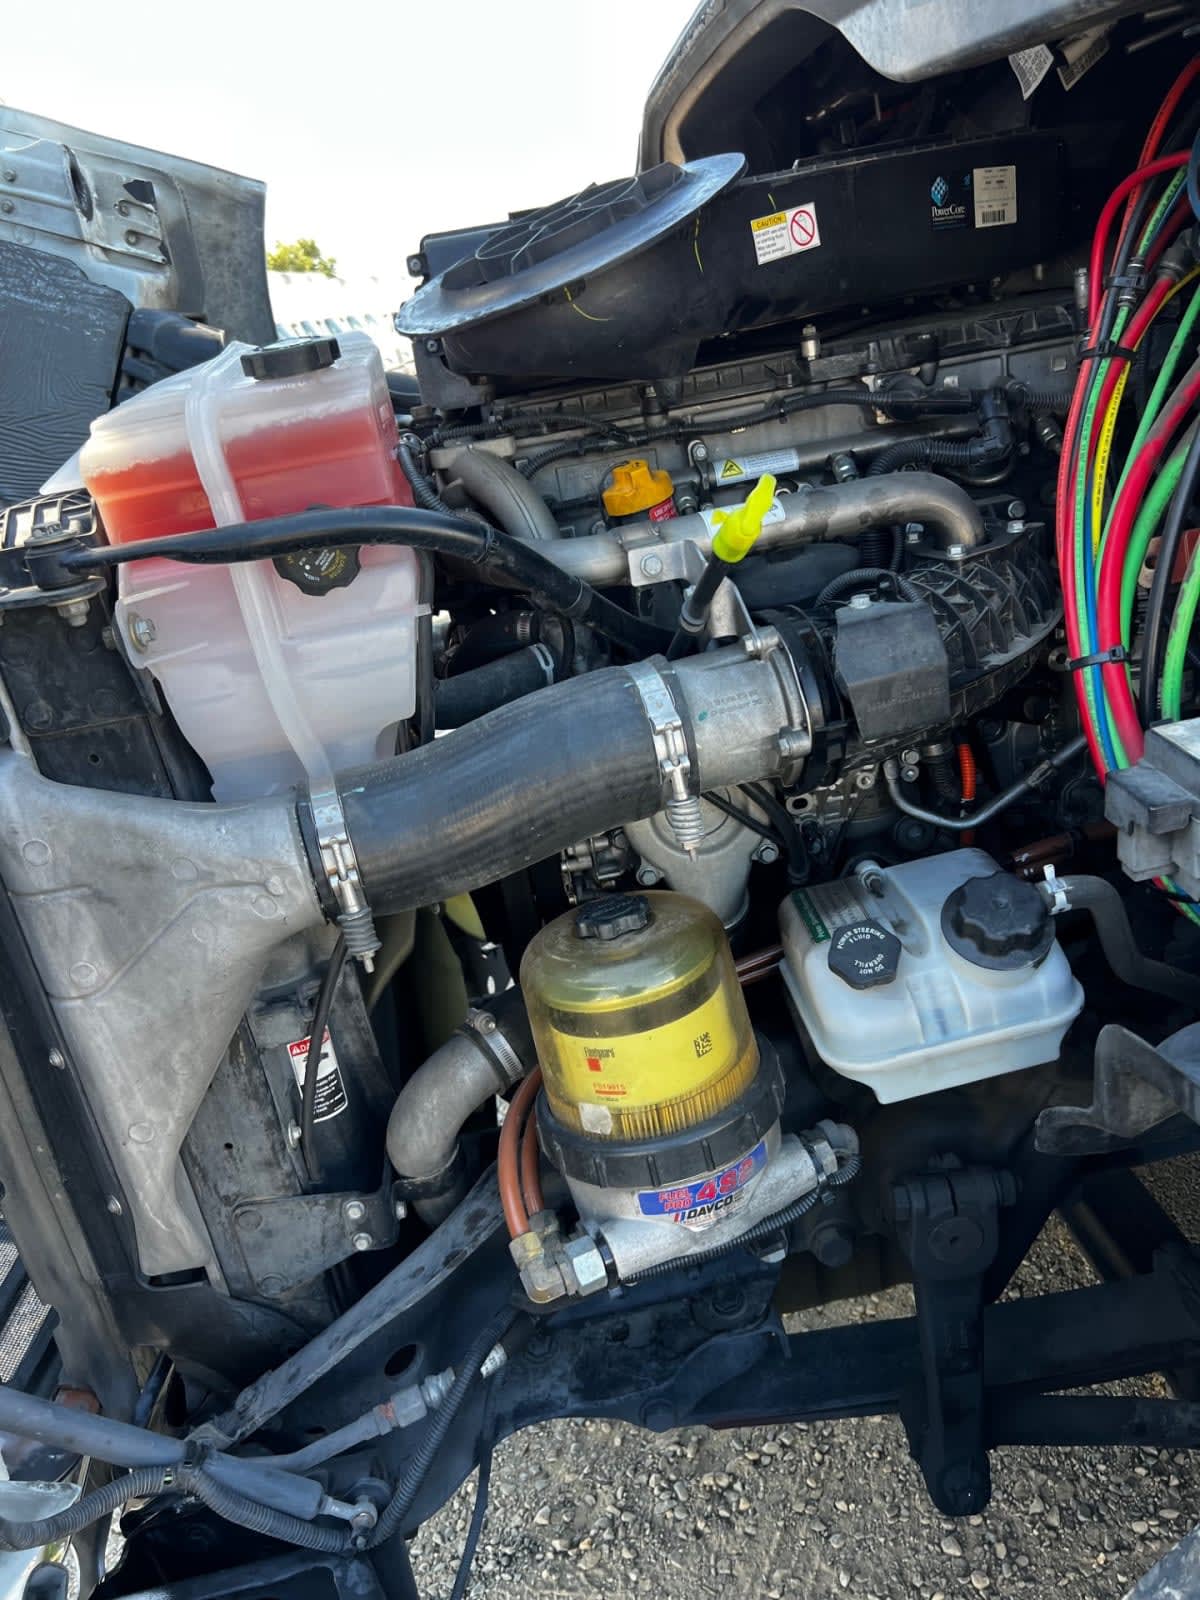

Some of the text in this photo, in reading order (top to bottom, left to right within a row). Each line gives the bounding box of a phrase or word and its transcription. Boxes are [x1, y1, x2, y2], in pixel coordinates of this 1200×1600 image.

[931, 203, 966, 217] PowerCore
[756, 215, 782, 230] CAUTION
[837, 927, 886, 949] POWER STEERING
[849, 934, 871, 944] FLUID
[658, 1187, 691, 1203] FUEL
[664, 1198, 693, 1212] PRO
